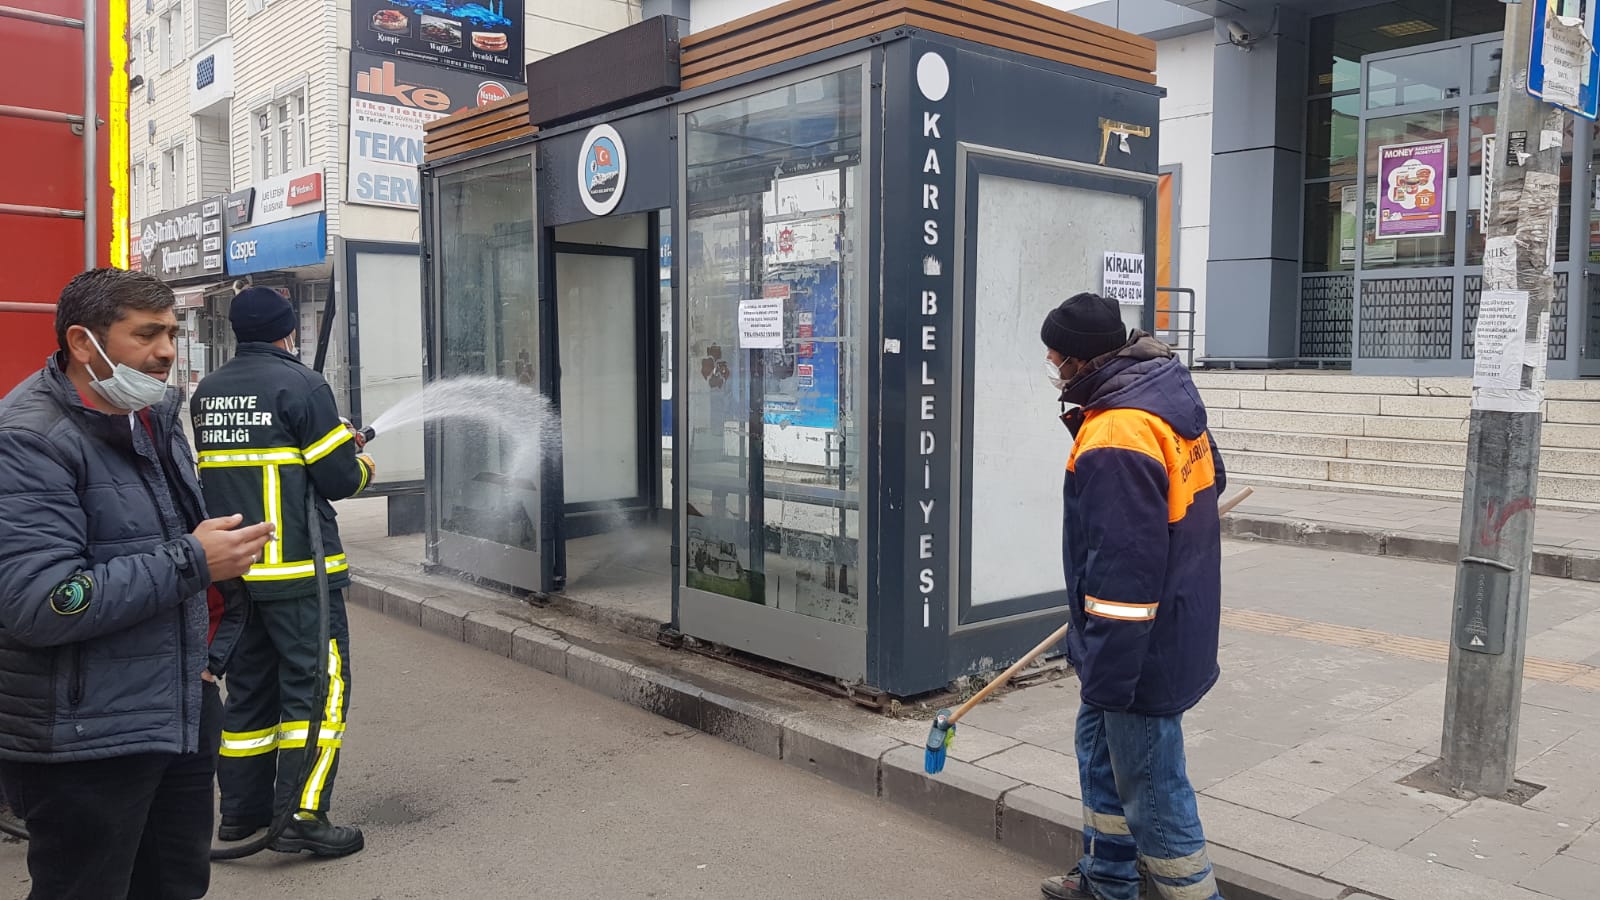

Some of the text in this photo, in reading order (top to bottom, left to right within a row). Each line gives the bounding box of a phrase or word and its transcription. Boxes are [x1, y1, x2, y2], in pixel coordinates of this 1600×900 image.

[1384, 148, 1414, 159] MONEY
[922, 111, 942, 246] KARS
[230, 240, 258, 264] Casper
[1106, 252, 1143, 274] KİRALIK
